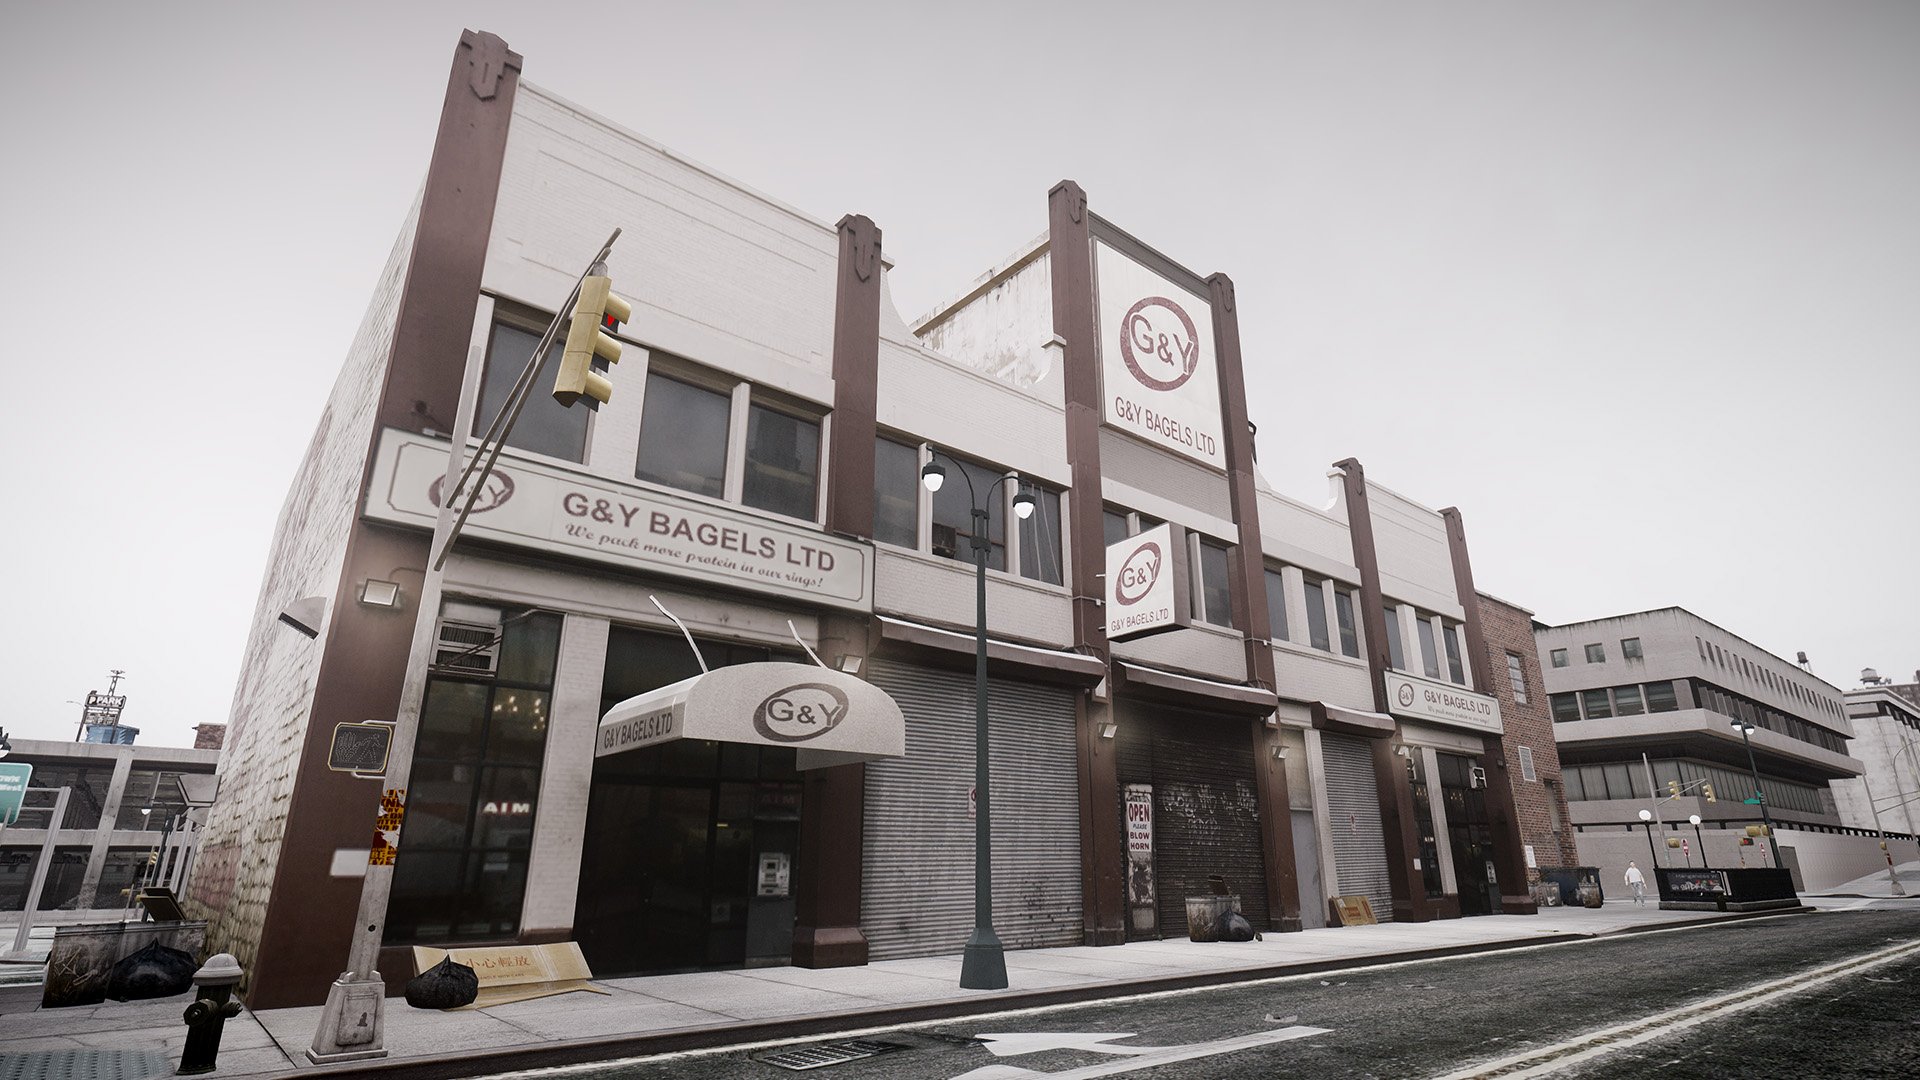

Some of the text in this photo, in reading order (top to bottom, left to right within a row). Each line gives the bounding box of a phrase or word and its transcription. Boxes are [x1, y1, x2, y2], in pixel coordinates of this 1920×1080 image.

[1130, 314, 1194, 375] G&Y
[1115, 396, 1216, 456] G&Y BAGELS LTD
[563, 492, 835, 572] G&Y BAGELS LTD
[565, 522, 824, 588] We pack more protein in our rings!
[1121, 558, 1158, 588] G&Y
[1111, 608, 1169, 632] G&Y BAGELS LTD
[97, 697, 123, 706] PARK
[767, 698, 842, 726] G&Y
[1424, 689, 1442, 705] G&Y
[1443, 694, 1476, 712] BAGELS
[1476, 703, 1491, 716] LTD
[604, 711, 673, 749] G&Y BAGELS LTD
[1128, 803, 1150, 822] OPEN
[1129, 831, 1150, 840] BLOW
[1130, 842, 1150, 850] HORN
